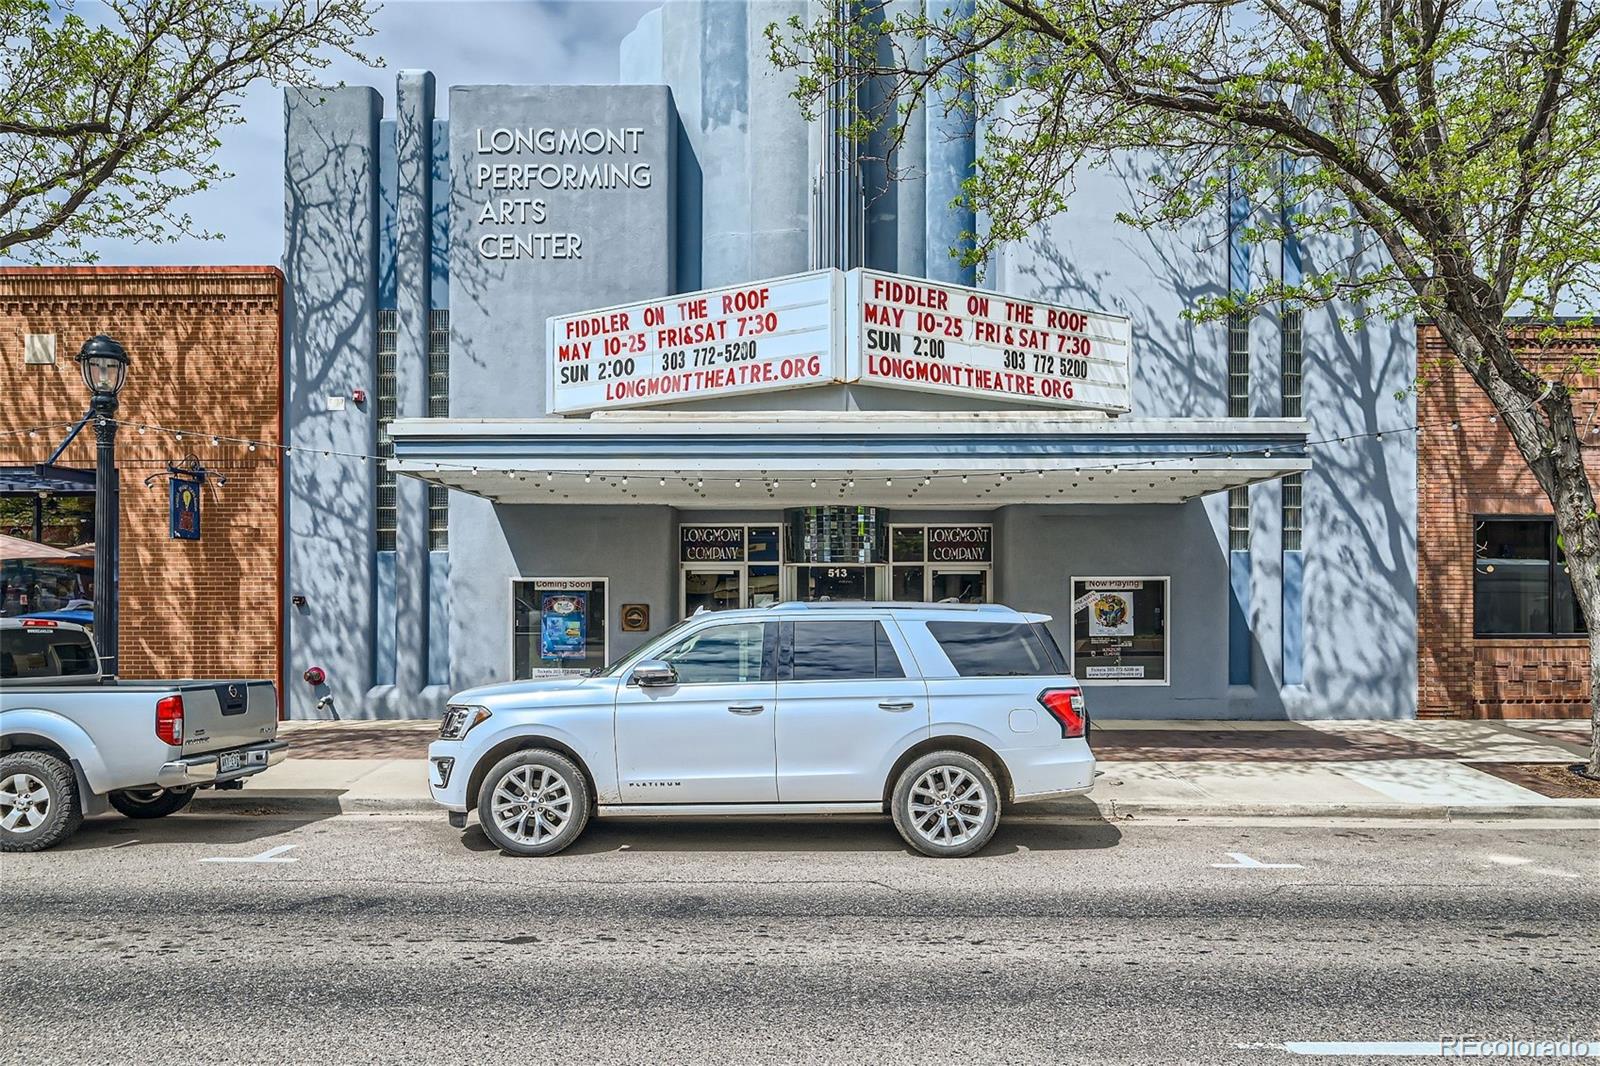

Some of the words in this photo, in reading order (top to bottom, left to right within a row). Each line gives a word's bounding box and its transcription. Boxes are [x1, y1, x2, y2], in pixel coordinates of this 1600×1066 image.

[476, 128, 644, 154] LONGMONT
[477, 163, 651, 189] PERFORMING
[478, 199, 546, 224] ARTS
[478, 233, 582, 259] CENTER
[566, 313, 630, 339] FIDDLER
[643, 307, 665, 327] ON
[678, 299, 708, 321] THE
[722, 288, 769, 315] ROOF
[874, 280, 948, 311] FIDDLER
[967, 295, 989, 317] ON
[1005, 302, 1034, 325] THE
[1047, 309, 1088, 333] ROOF
[558, 341, 592, 362] MAY
[604, 333, 647, 357] 10-25
[737, 312, 778, 336] 7:30
[864, 303, 904, 328] MAY
[917, 312, 963, 338] 10-25
[1057, 334, 1091, 356] 7:30
[560, 364, 589, 384] SUN
[598, 357, 635, 380] 2:00
[662, 350, 686, 371] 303
[693, 340, 757, 367] 772-5200
[866, 328, 901, 353] SUN
[913, 335, 945, 359] 2:00
[1003, 349, 1026, 370] 303
[1033, 354, 1054, 374] 772
[1060, 357, 1088, 379] 5200
[606, 355, 821, 400] LONGMONTTHEATRE.ORG
[683, 528, 743, 542] LONGMONT
[929, 528, 989, 542] LONGMONT
[687, 547, 739, 559] COMPANY
[933, 547, 985, 559] COMPANY
[536, 581, 567, 589] Coming
[827, 568, 848, 578] 513
[1109, 580, 1139, 588] Playing
